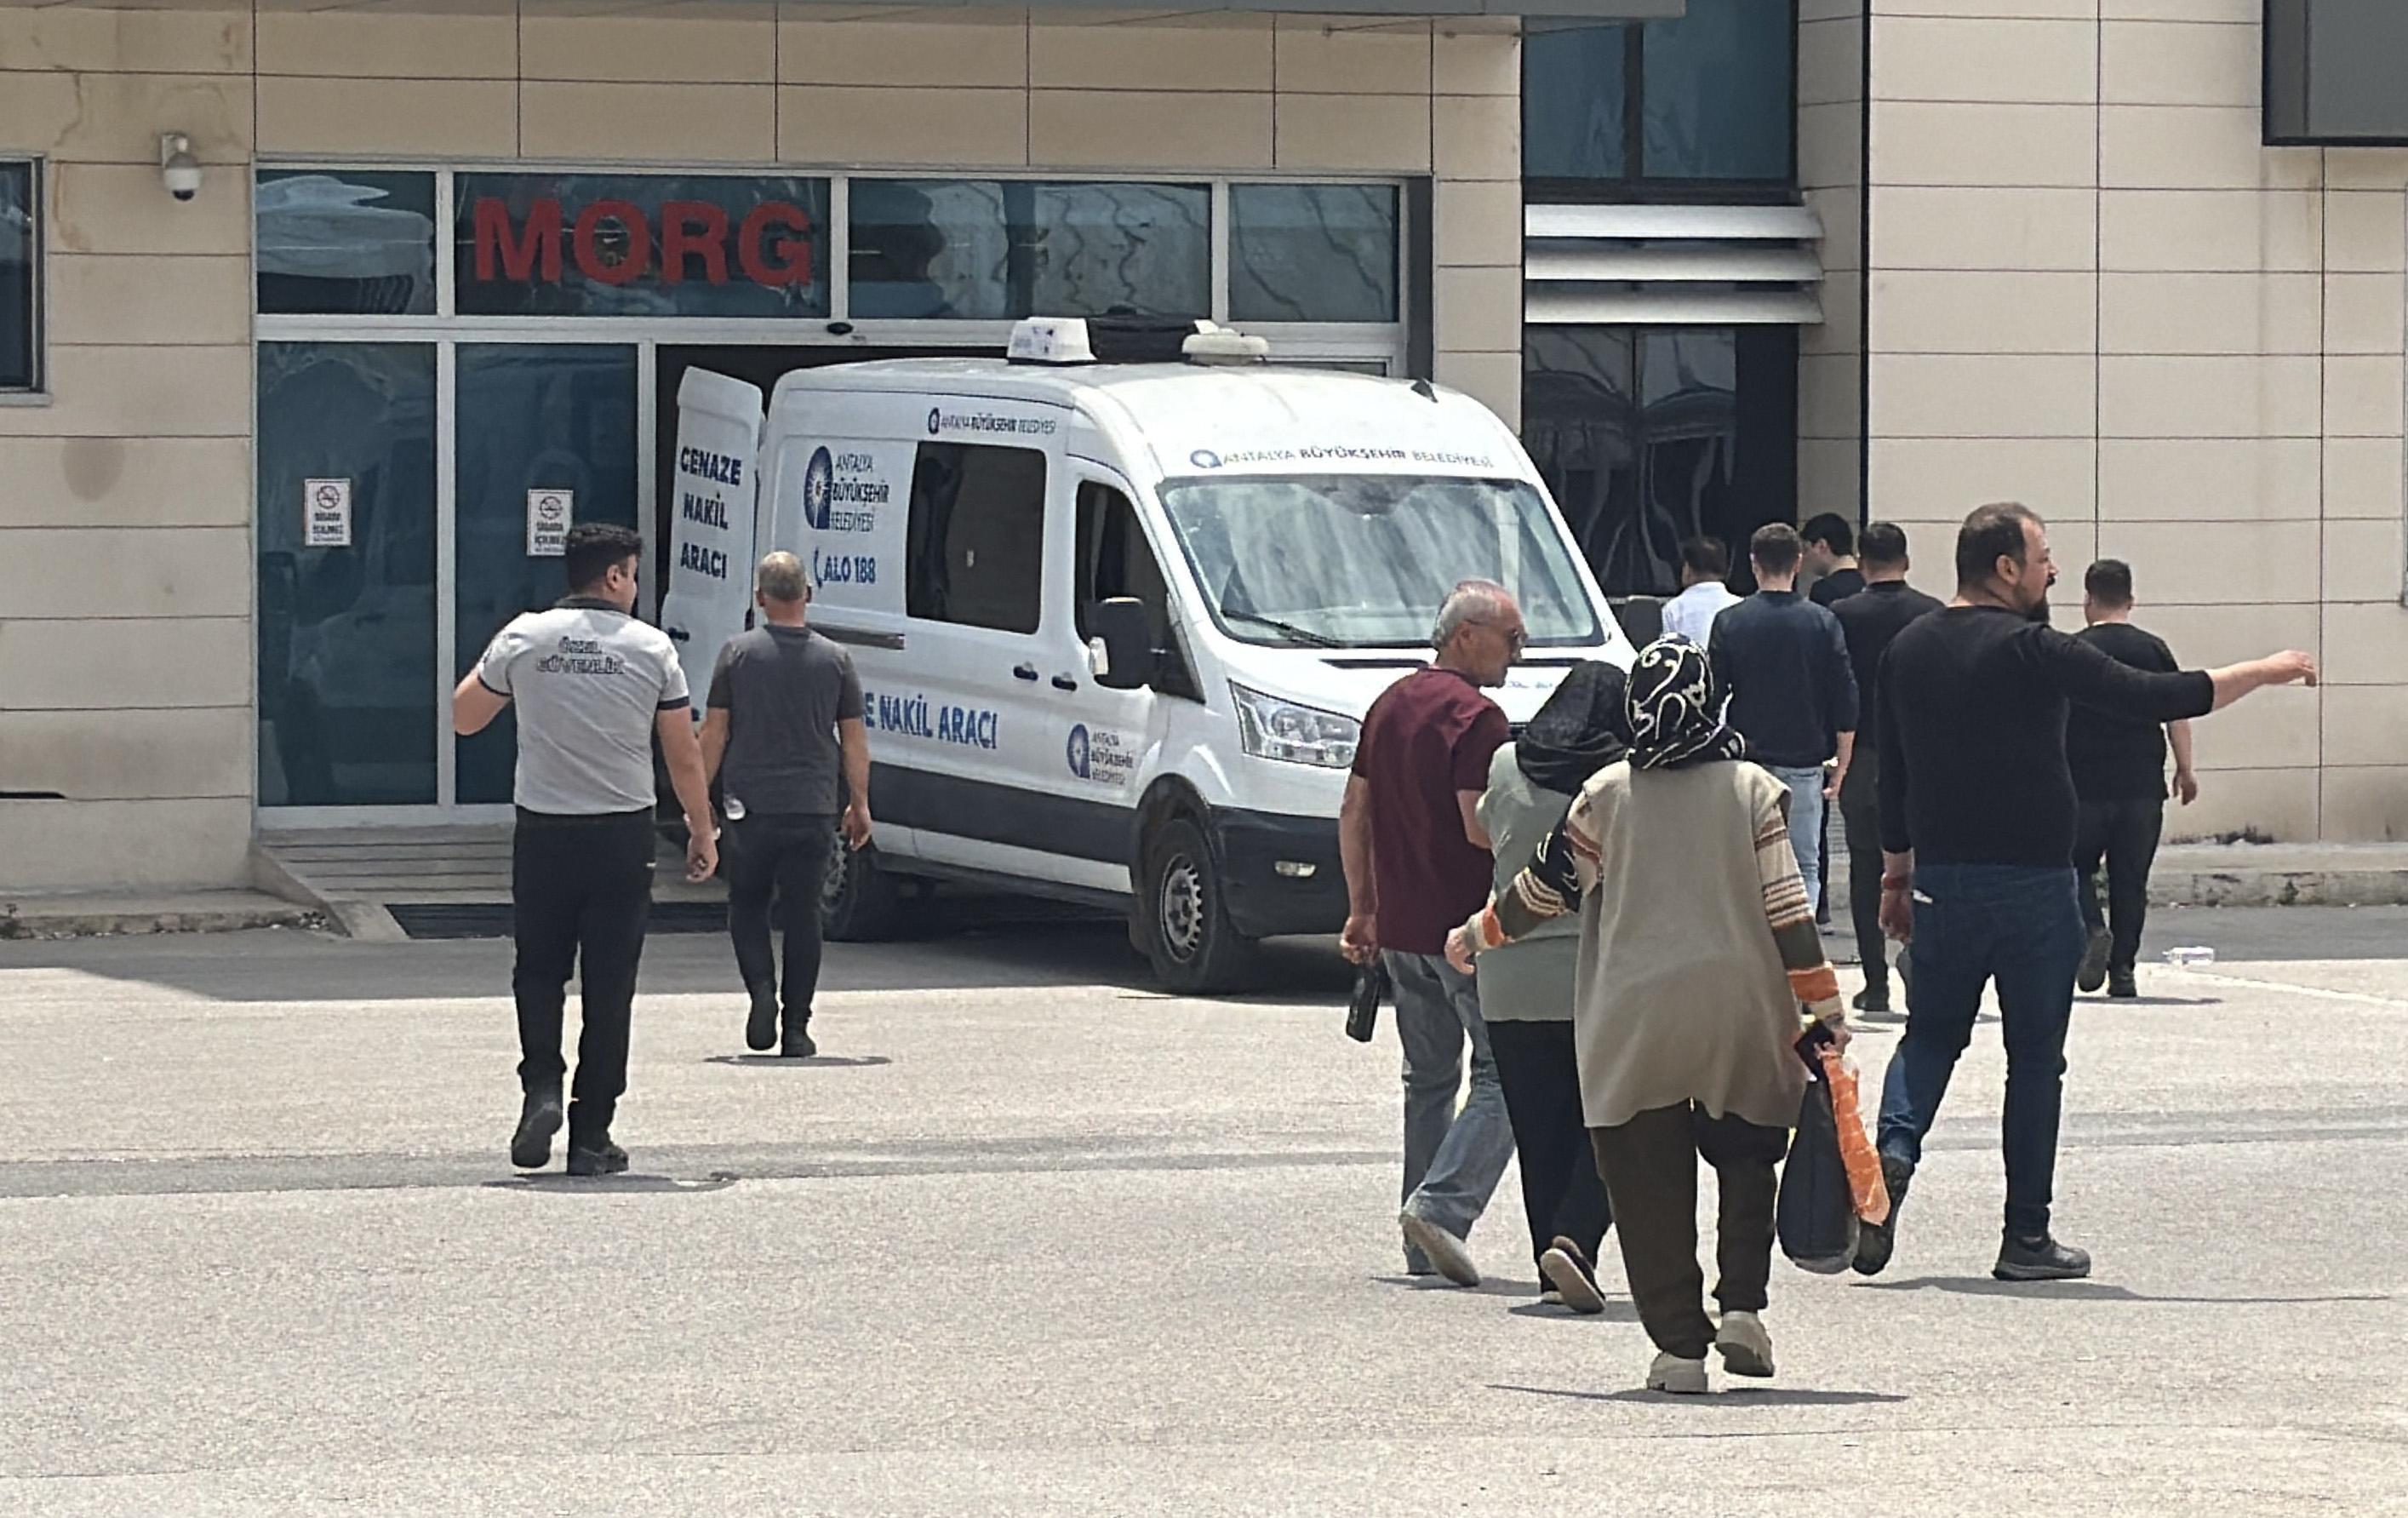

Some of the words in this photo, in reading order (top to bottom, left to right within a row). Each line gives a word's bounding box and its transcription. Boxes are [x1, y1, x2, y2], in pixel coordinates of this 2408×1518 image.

[473, 197, 812, 287] MORG
[680, 446, 742, 486] CENAZE
[835, 453, 873, 473] ANTALYA
[1223, 450, 1295, 464] ANTALYA
[1298, 444, 1406, 460] BÜYÜKŞEHİR
[683, 490, 729, 530] NAKİL
[832, 477, 889, 507] BÜYÜKŞEHİR
[680, 542, 728, 580] ARACI
[823, 555, 851, 582] ALO
[855, 556, 877, 584] 188
[879, 693, 934, 738] NAKİL
[937, 705, 998, 750] ARACI
